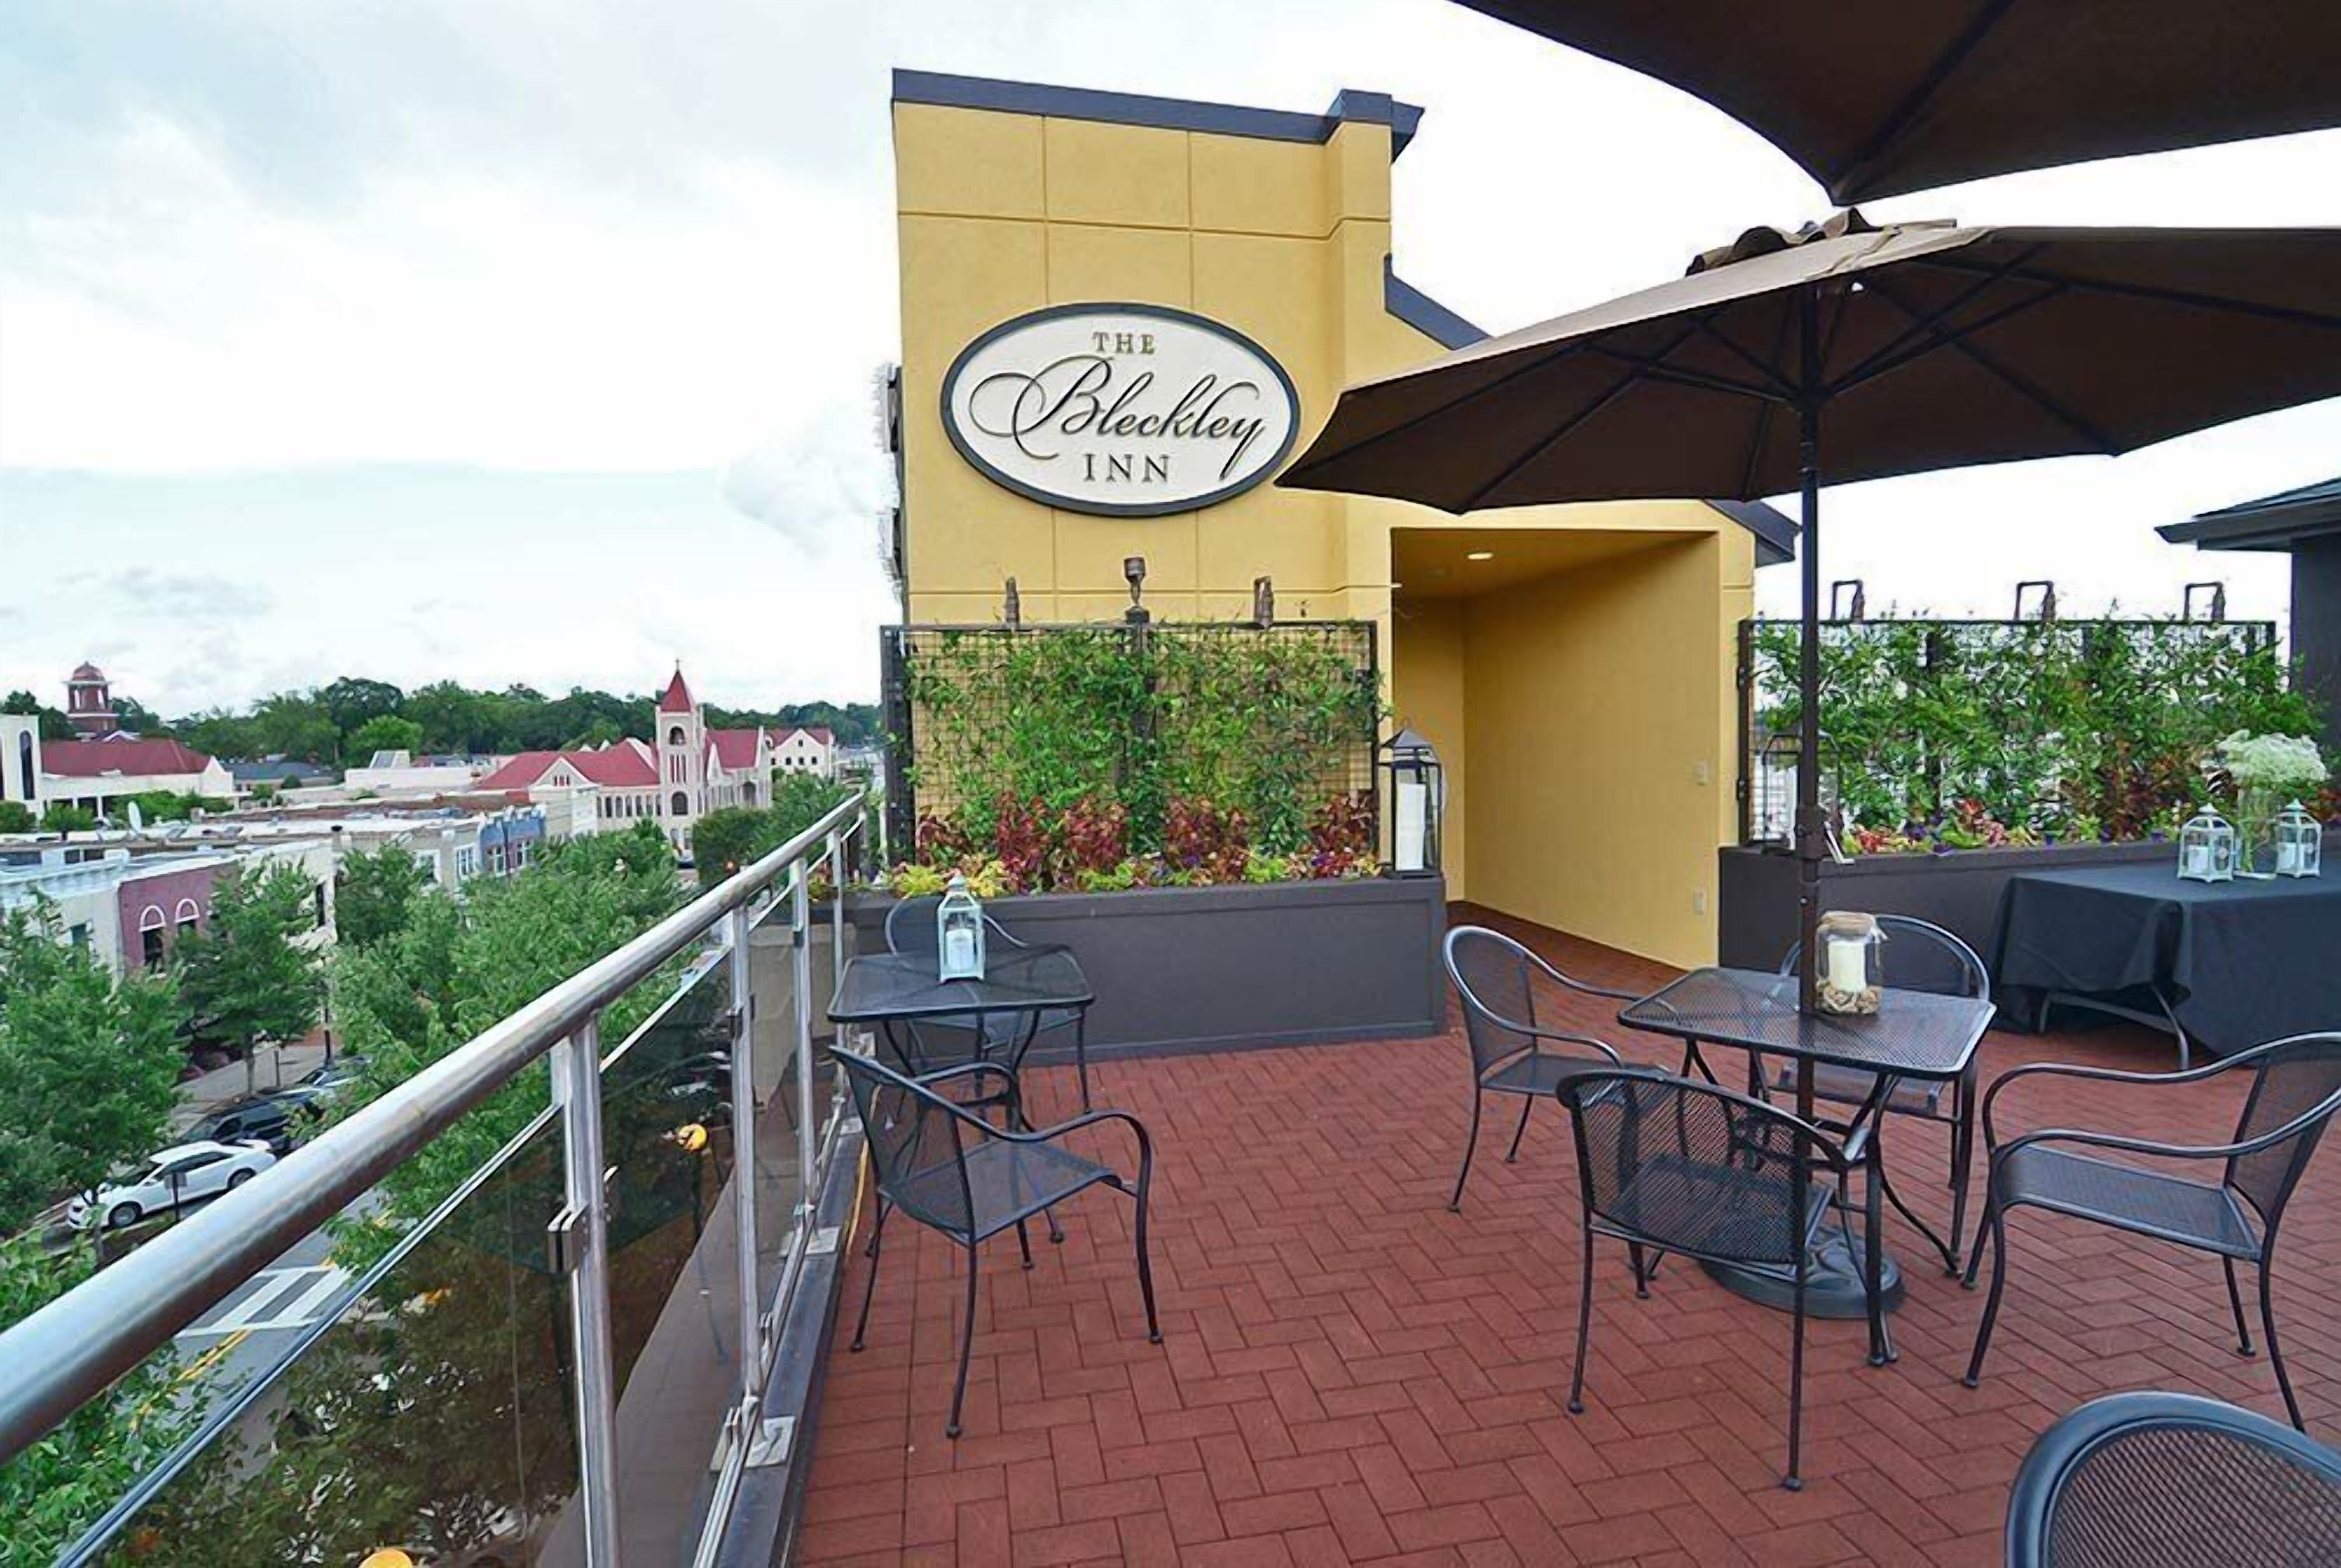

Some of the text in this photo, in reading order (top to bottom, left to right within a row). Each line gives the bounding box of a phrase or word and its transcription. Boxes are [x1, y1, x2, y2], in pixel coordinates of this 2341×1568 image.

[1092, 331, 1156, 355] THE
[969, 355, 1268, 481] Bleckley
[1083, 453, 1171, 484] INN
